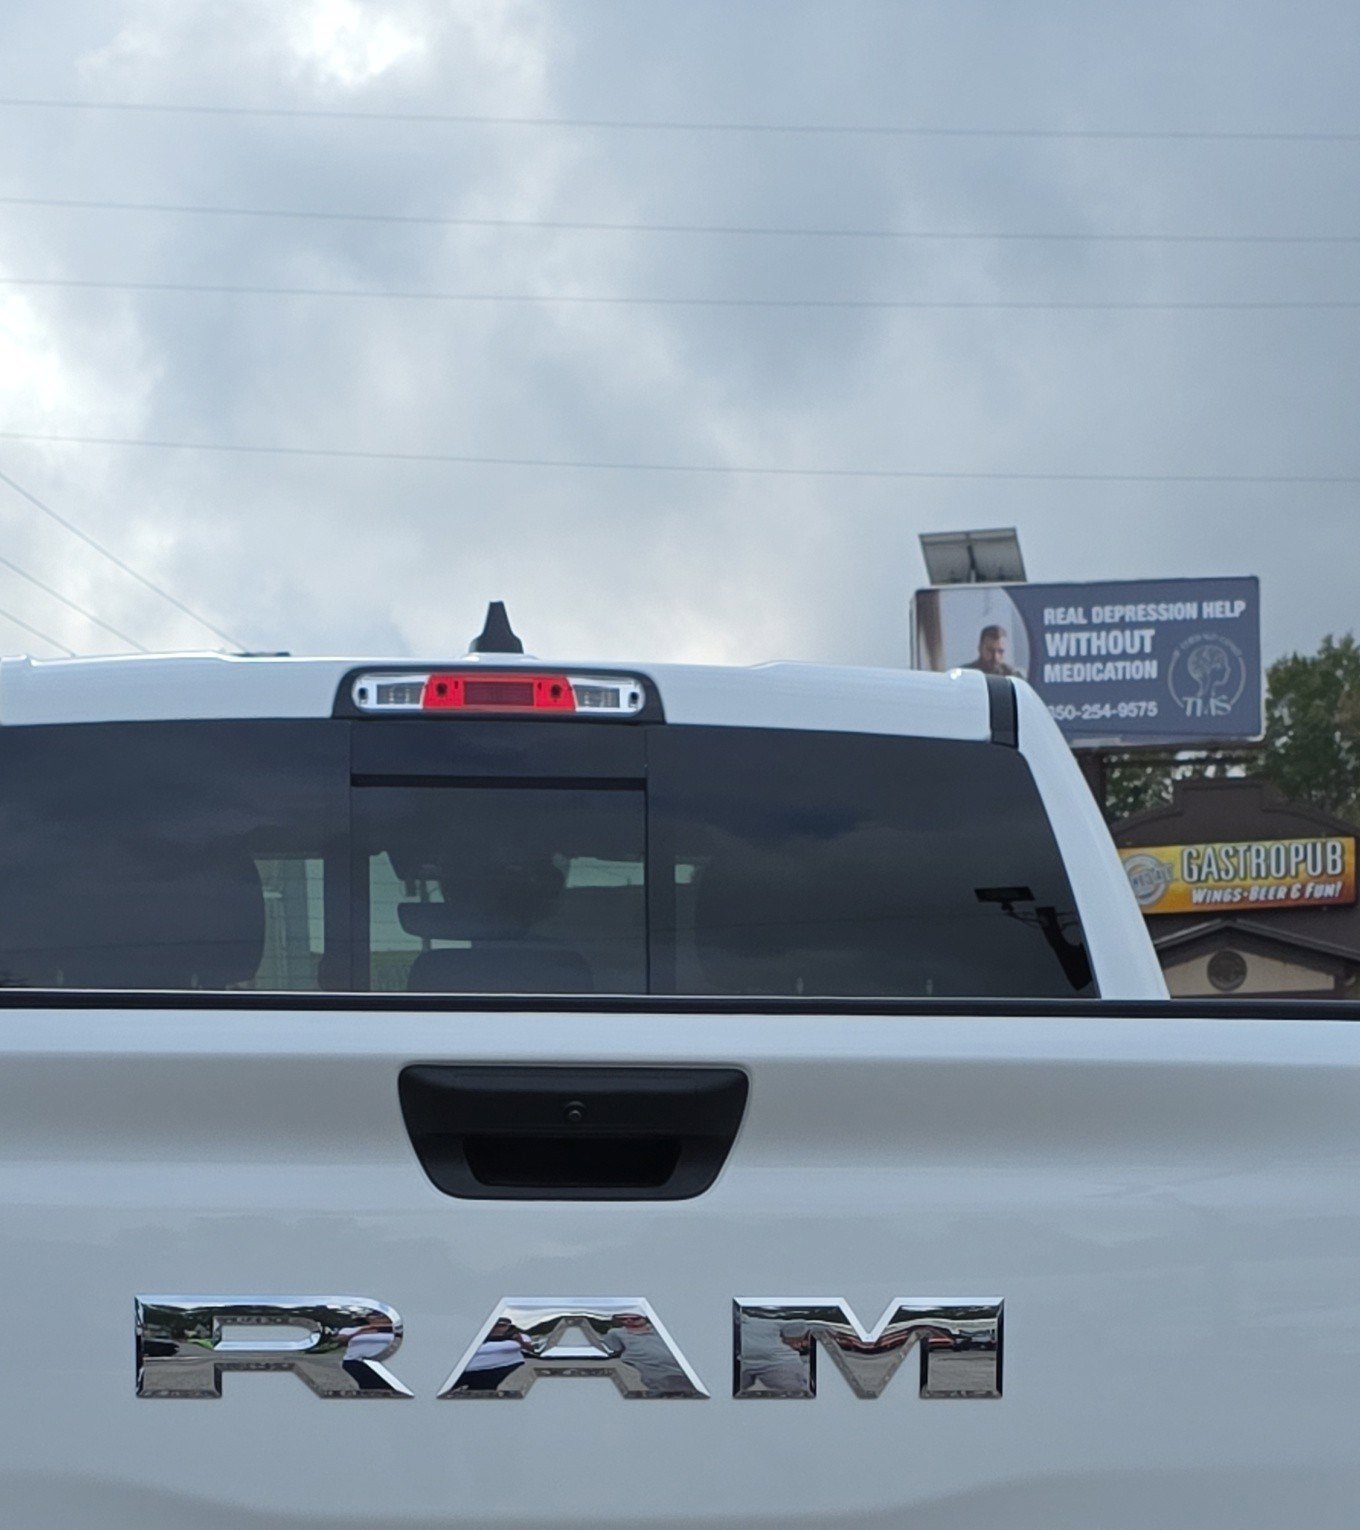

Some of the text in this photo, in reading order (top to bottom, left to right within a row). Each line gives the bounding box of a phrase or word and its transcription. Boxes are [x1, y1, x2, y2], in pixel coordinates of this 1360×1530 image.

[1043, 600, 1247, 626] REAL DEPRESSION HELP
[1045, 629, 1156, 657] WITHOUT
[1044, 660, 1158, 683] MEDICATION
[1182, 840, 1344, 883] GASTROPUB
[1304, 880, 1343, 899] FUN!
[134, 1293, 1006, 1400] RAM
